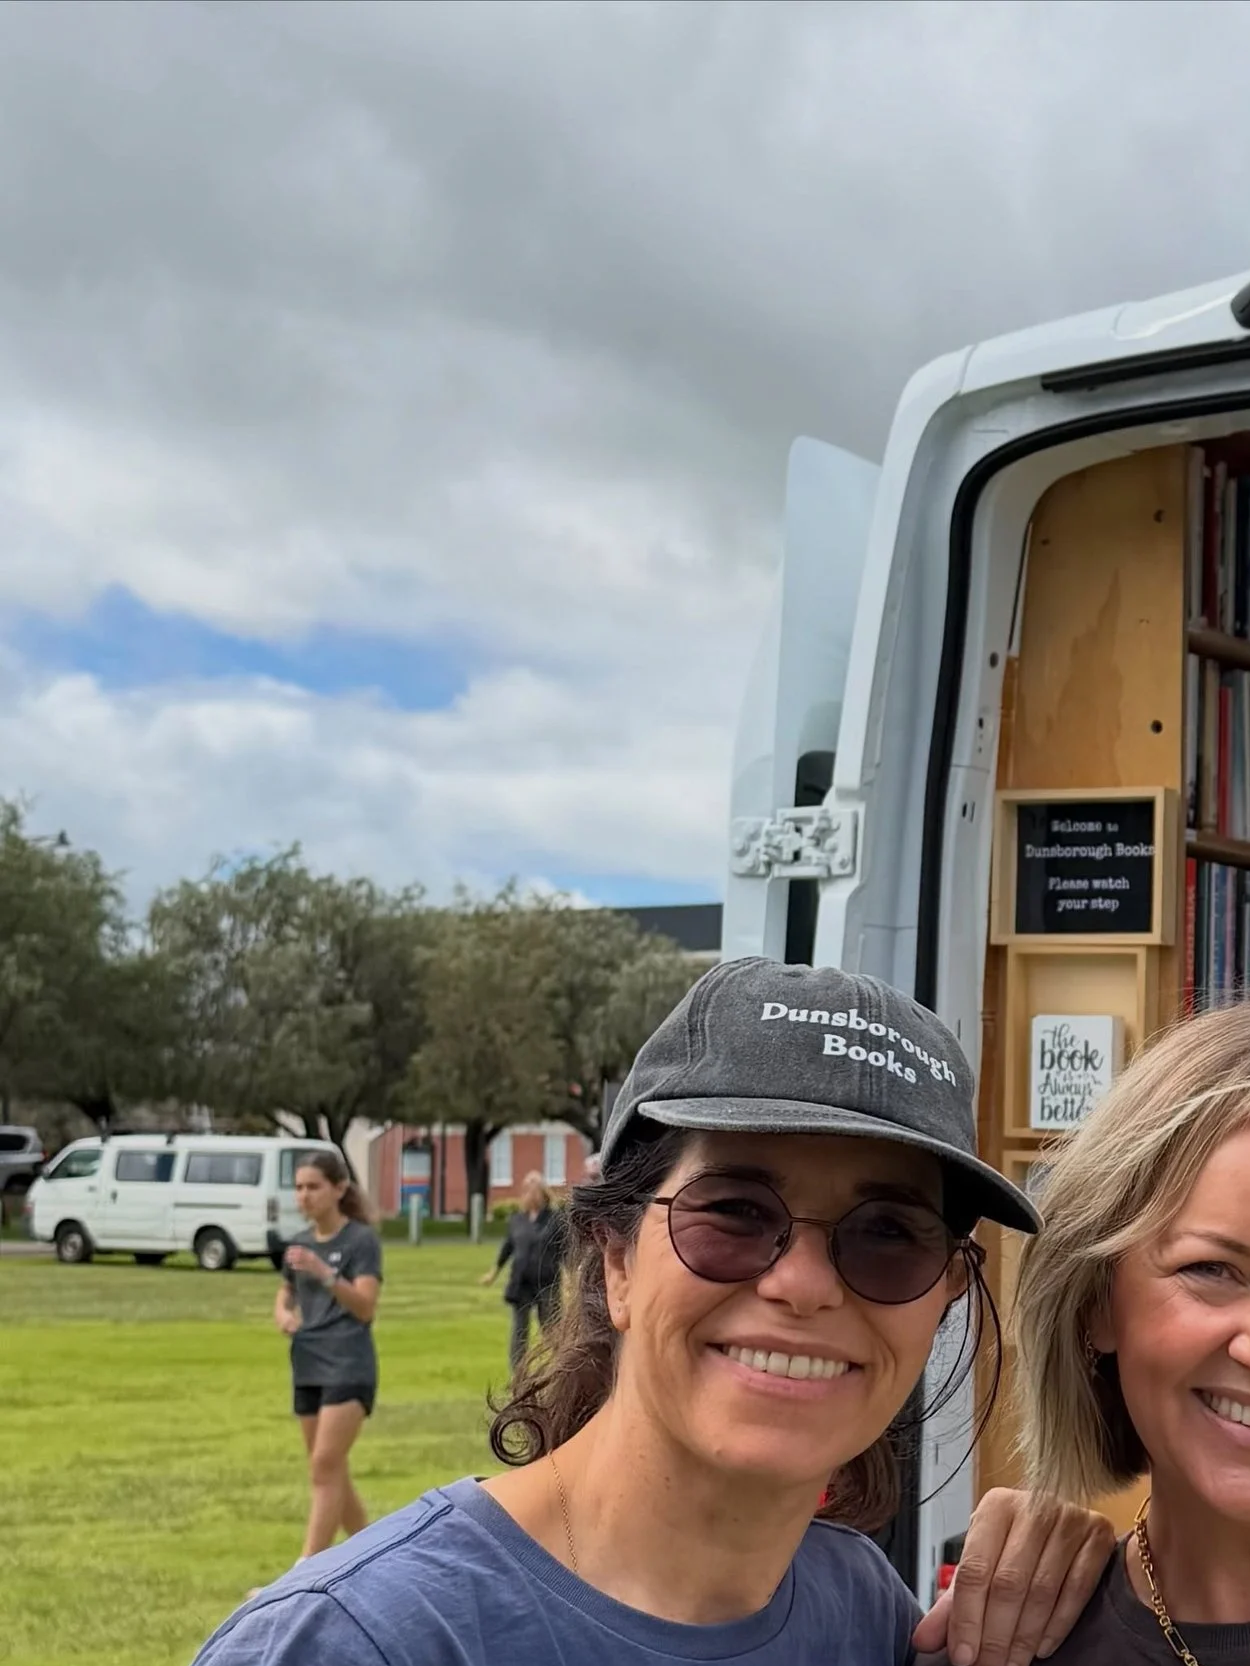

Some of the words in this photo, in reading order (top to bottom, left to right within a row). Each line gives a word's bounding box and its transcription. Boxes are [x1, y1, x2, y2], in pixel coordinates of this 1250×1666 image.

[1051, 820, 1102, 832] Welcome
[1025, 843, 1112, 860] Dunsborough
[1115, 842, 1156, 857] Books
[1048, 877, 1089, 890] Please
[1092, 876, 1130, 890] watch
[1056, 898, 1090, 912] your
[1090, 897, 1119, 912] step
[761, 1002, 957, 1087] Dunsborough
[1043, 1024, 1077, 1048] the
[823, 1034, 917, 1083] Books
[1040, 1039, 1103, 1071] book
